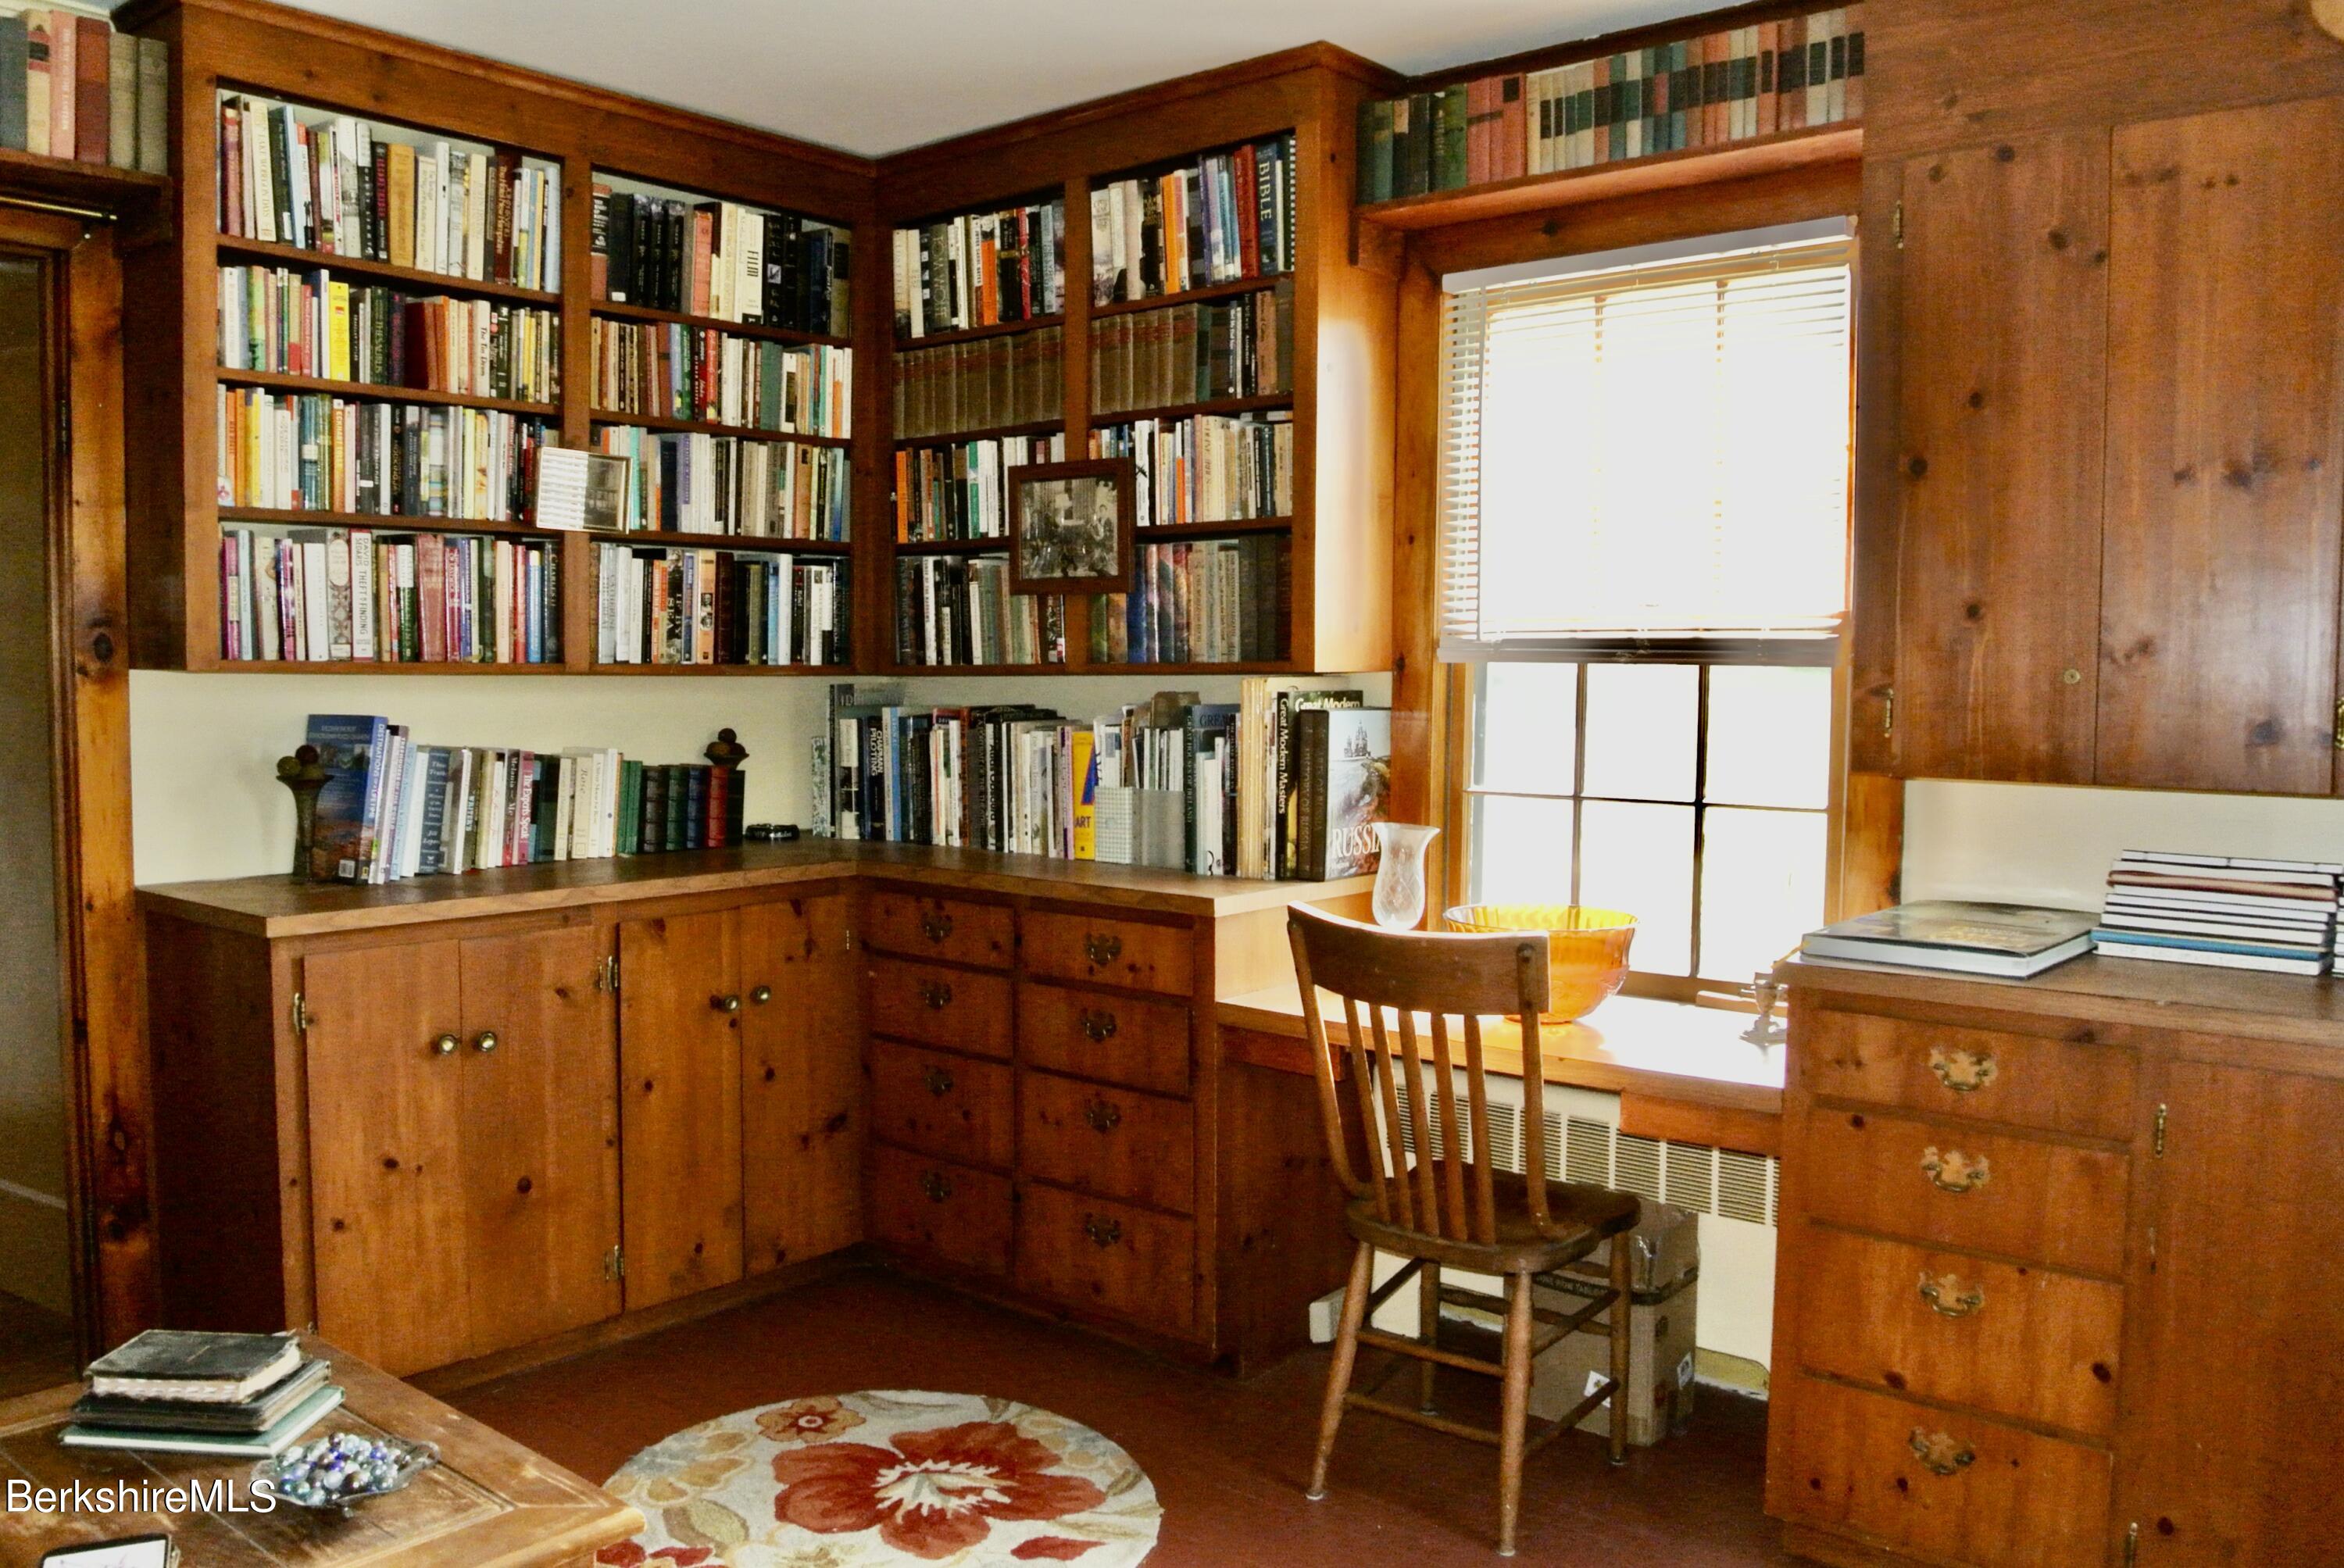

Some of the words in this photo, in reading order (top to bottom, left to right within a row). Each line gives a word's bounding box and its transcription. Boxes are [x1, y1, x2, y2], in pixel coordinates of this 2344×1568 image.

[1259, 161, 1272, 221] BIBLE
[747, 250, 759, 277] FILM
[375, 320, 384, 373] THESAURUS
[359, 570, 368, 595] THEFT
[359, 602, 369, 634] FINDING
[1279, 698, 1289, 727] Great
[373, 723, 385, 777] DESTINATIONS
[869, 727, 878, 777] PILOTING
[1278, 727, 1289, 770] Modern
[509, 756, 518, 788] Melania
[579, 768, 588, 795] Rose
[368, 789, 379, 818] LIFETIME
[520, 788, 531, 816] Experts
[1278, 772, 1288, 814] Masters
[466, 795, 474, 832] WRITER'S
[520, 817, 531, 839] Speak
[1074, 816, 1092, 828] ART
